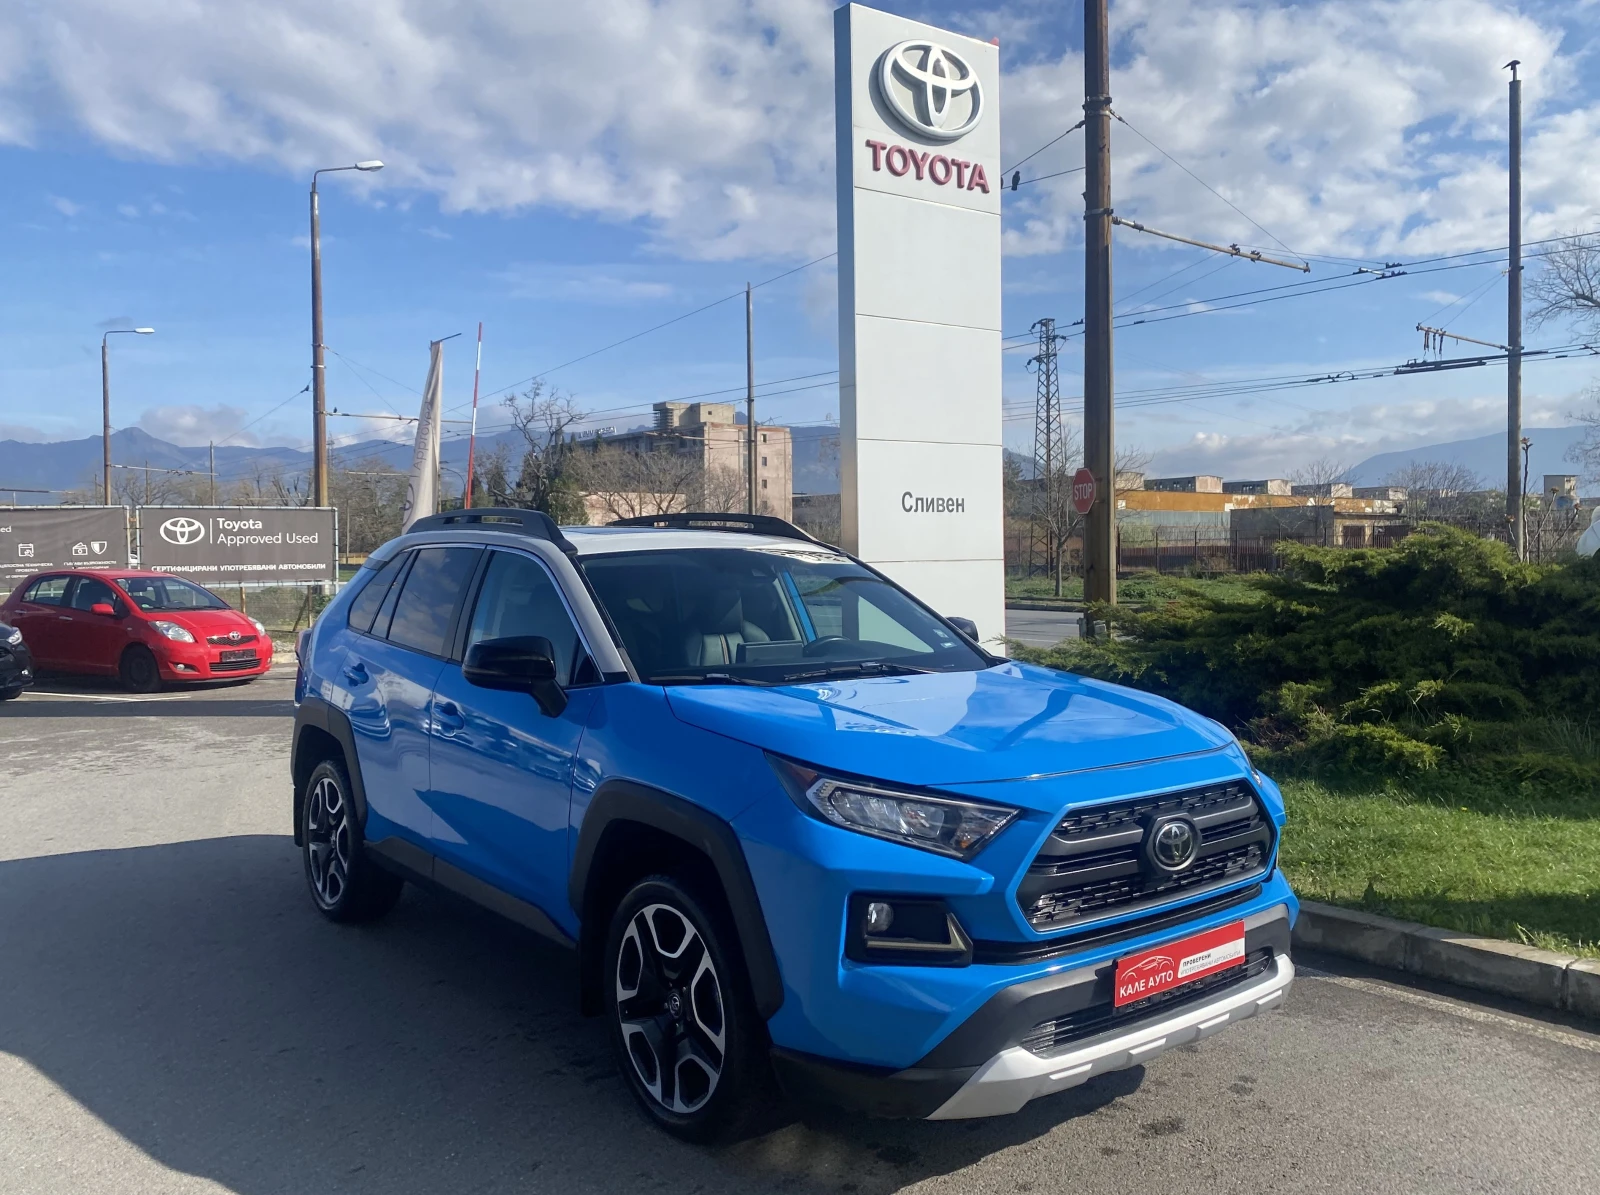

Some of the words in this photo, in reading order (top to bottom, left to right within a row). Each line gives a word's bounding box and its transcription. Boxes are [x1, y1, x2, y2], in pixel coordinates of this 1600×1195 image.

[865, 139, 990, 194] TOYOTA
[413, 401, 432, 471] Approved
[1074, 482, 1093, 500] STOP
[901, 491, 965, 513] Сливен
[0, 525, 12, 533] ed
[216, 517, 263, 534] Toyota
[216, 532, 282, 547] Approved
[286, 532, 319, 544] Used
[151, 565, 218, 573] СЕРТИФИЦИРАНИ
[220, 563, 277, 571] УПОТРЕБЯВАНИ
[1182, 953, 1212, 968] ПРОВЕРЕНИ
[1120, 979, 1146, 998] КАЛЕ
[1148, 970, 1174, 988] АУТО
